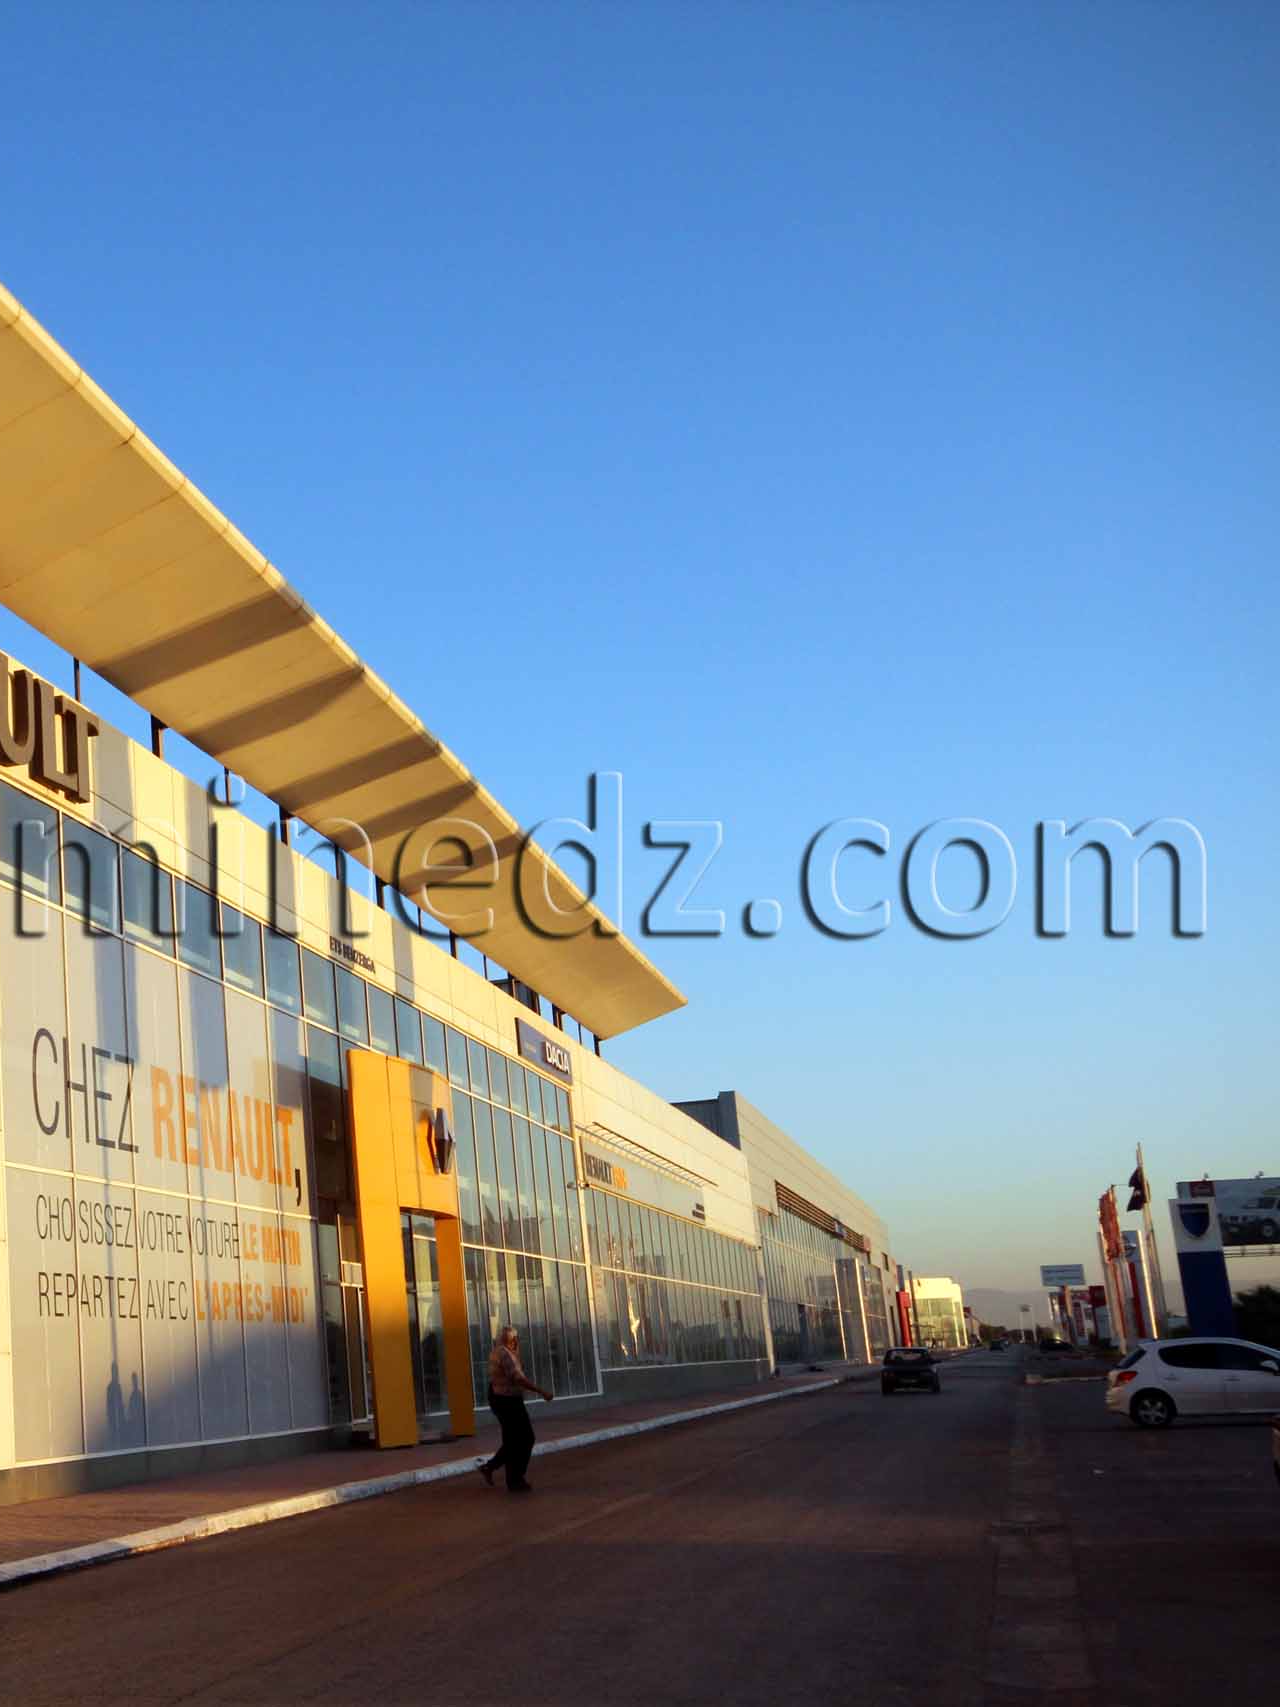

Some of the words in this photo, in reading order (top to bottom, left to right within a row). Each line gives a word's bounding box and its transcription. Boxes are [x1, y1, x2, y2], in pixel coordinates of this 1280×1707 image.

[543, 1039, 570, 1075] DACIA
[32, 1027, 140, 1154] CHEZ
[150, 1064, 302, 1207] RENAULT,
[36, 1194, 134, 1249] CHOSISSEZ
[137, 1209, 185, 1254] VOTRE
[38, 1271, 139, 1319] REPARTEZ
[146, 1279, 189, 1321] AVEC
